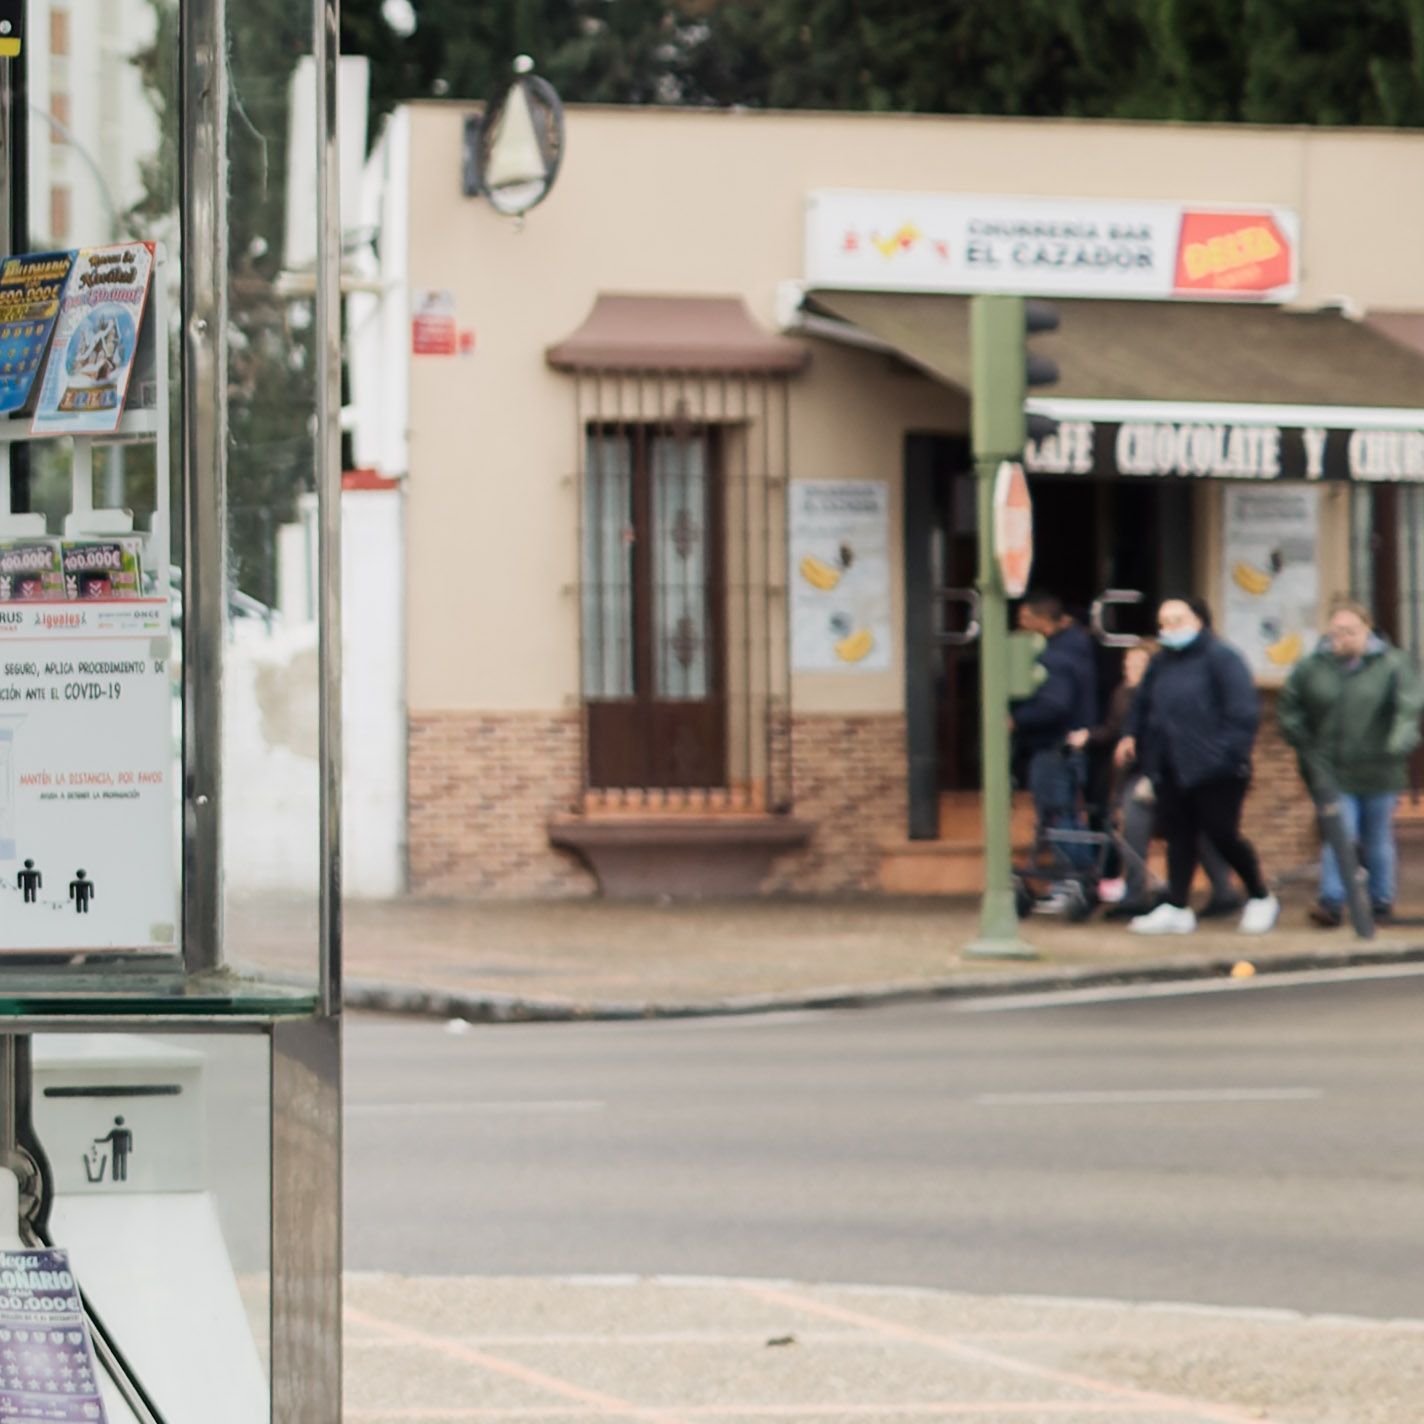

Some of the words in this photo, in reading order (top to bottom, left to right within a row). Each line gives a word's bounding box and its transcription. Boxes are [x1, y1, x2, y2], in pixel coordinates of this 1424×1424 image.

[966, 241, 1003, 265] EL
[1012, 241, 1154, 269] CAZADOR
[1116, 422, 1282, 477] CHOCOLATE
[1303, 427, 1328, 478] Y
[64, 550, 121, 571] 100.000€
[5, 663, 40, 677] SEGURO,
[45, 662, 74, 674] APLICA
[78, 661, 146, 674] PROCEDIMIENTO
[154, 661, 165, 673] DE
[26, 687, 46, 700] ANTE
[51, 687, 59, 700] EL
[65, 682, 121, 700] COVID-19
[56, 773, 65, 785] LA
